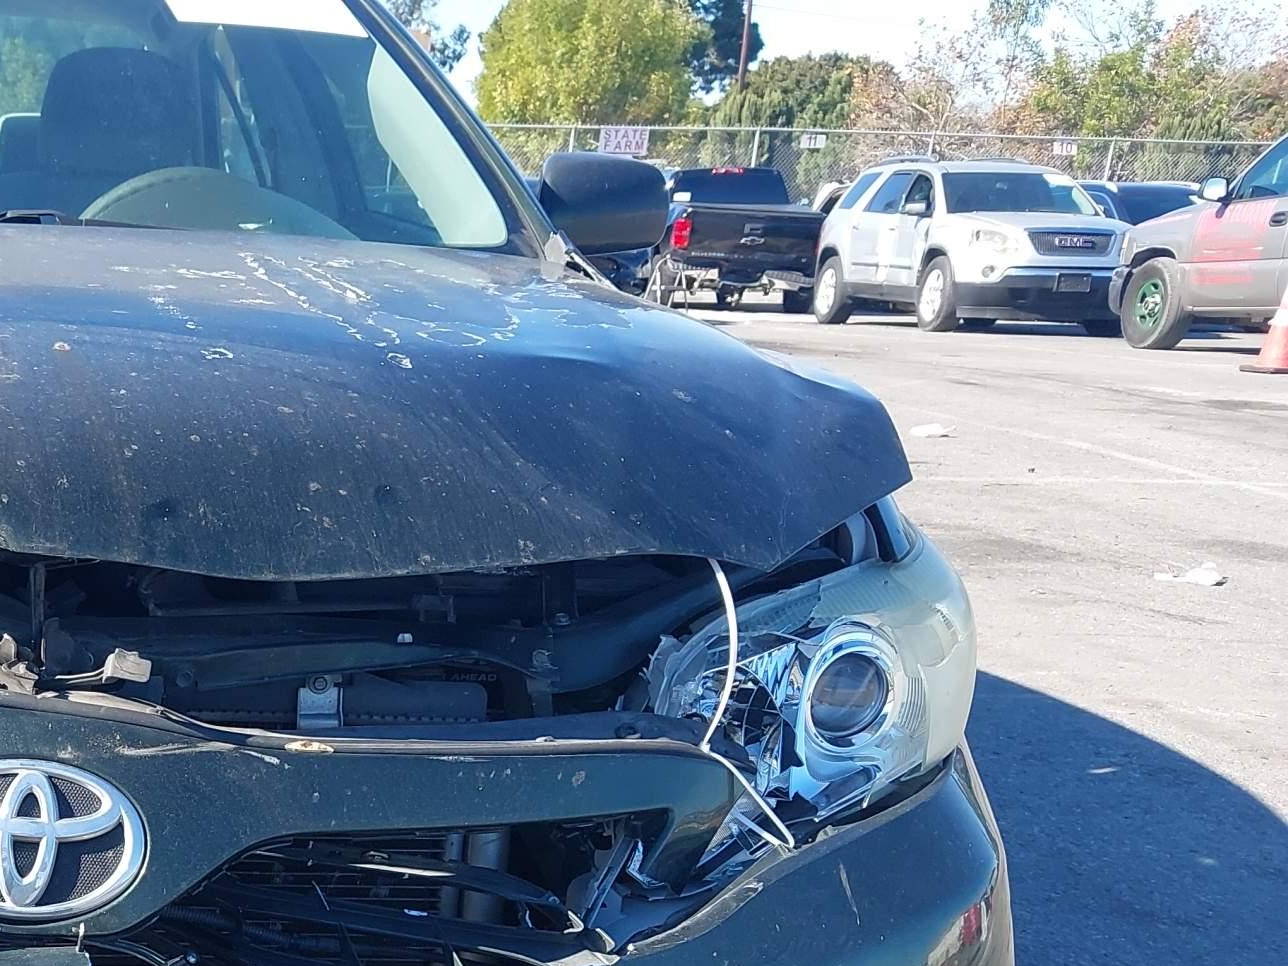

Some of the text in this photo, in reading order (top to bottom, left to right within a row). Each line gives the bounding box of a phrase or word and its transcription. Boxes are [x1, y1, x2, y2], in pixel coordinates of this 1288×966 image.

[603, 129, 648, 140] STATE
[603, 140, 645, 151] FARM
[1059, 142, 1072, 154] 10
